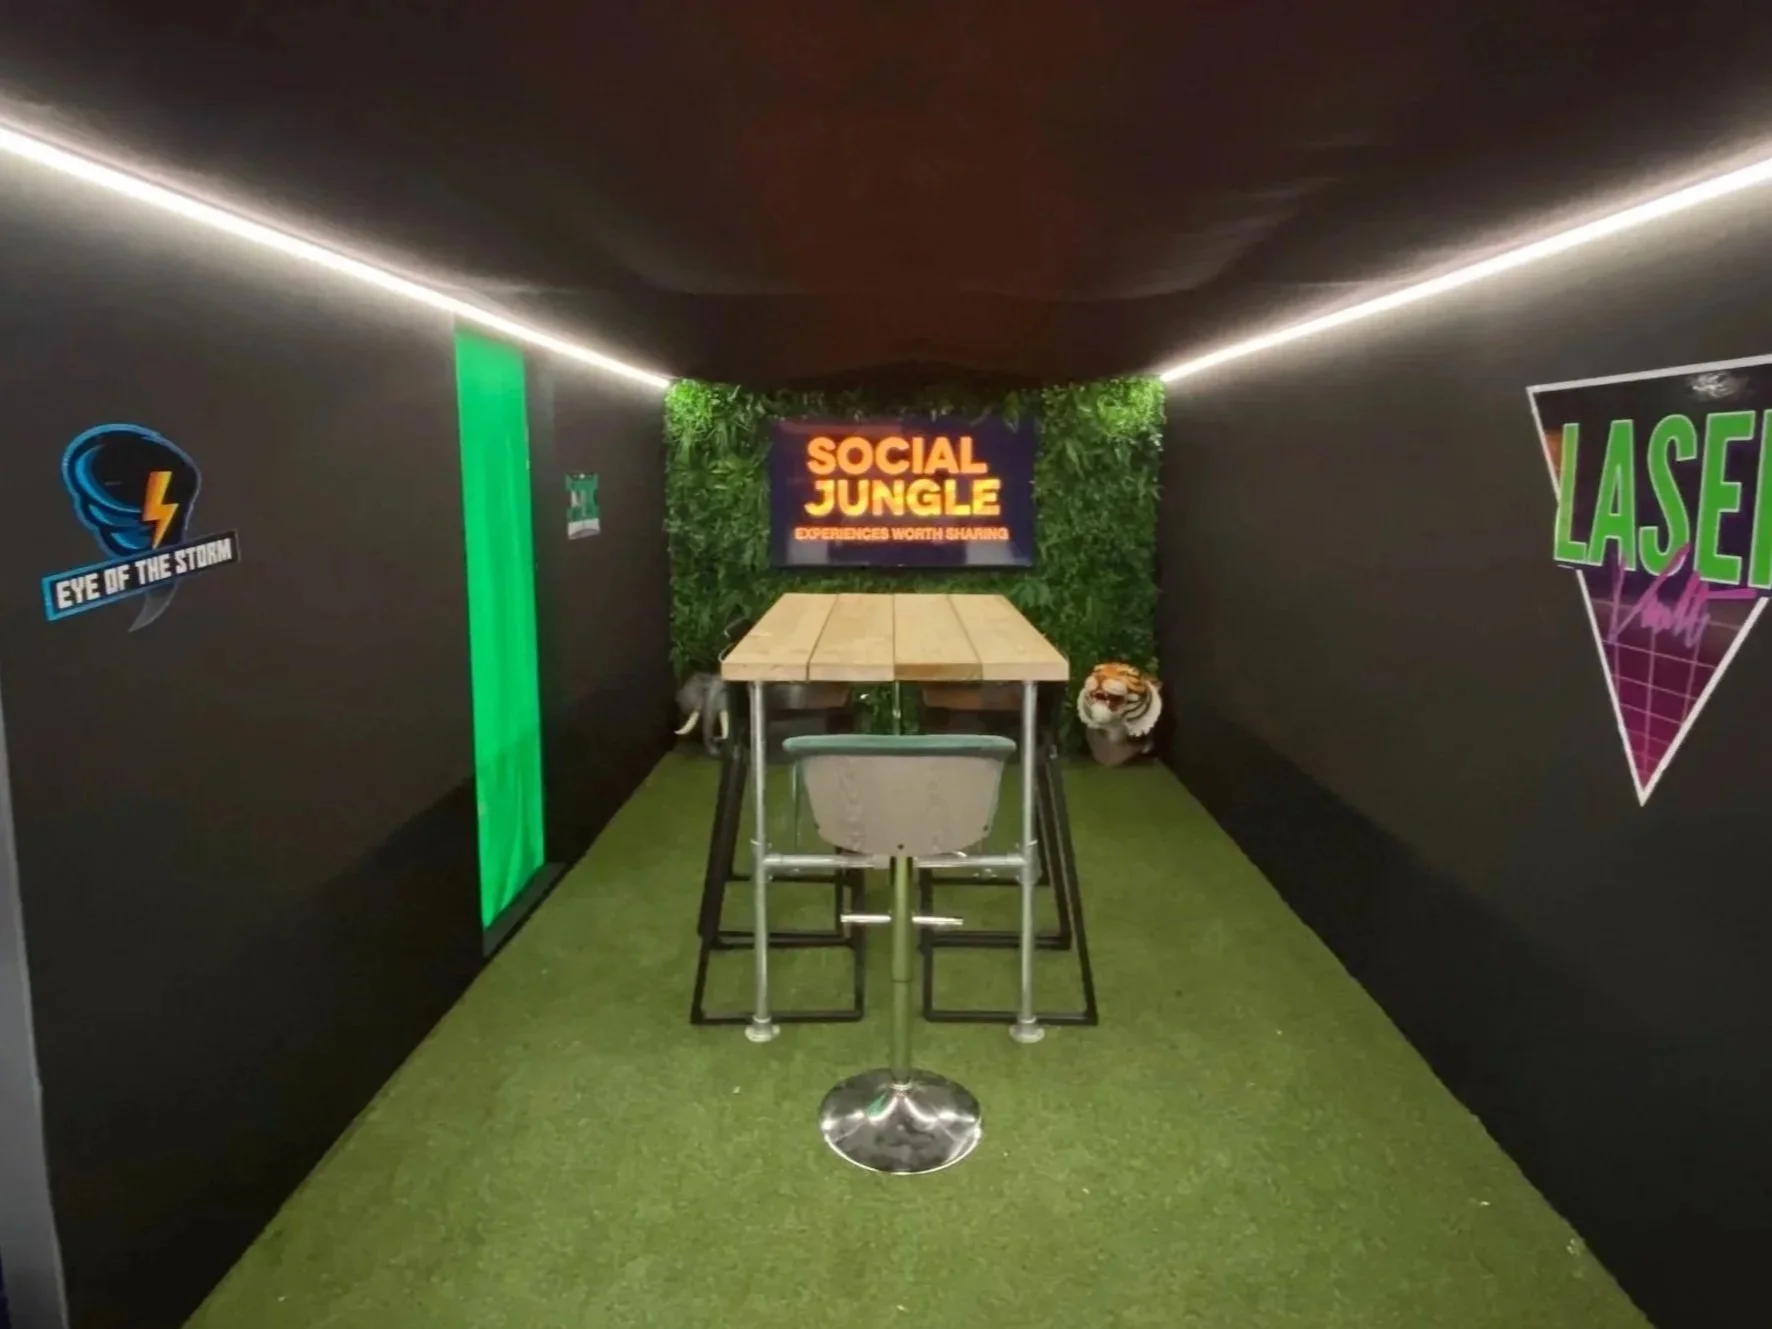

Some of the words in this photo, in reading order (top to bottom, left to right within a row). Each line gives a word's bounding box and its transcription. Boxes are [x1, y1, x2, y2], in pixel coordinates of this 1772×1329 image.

[806, 436, 988, 475] SOCIAL
[804, 478, 1001, 517] JUNGLE
[795, 527, 889, 541] EXPERIENCES
[891, 527, 944, 541] WORTH
[945, 527, 1009, 541] SHARING
[55, 572, 101, 610] EYE
[104, 563, 131, 596] OF
[134, 553, 172, 585] THE
[174, 537, 233, 574] STORM
